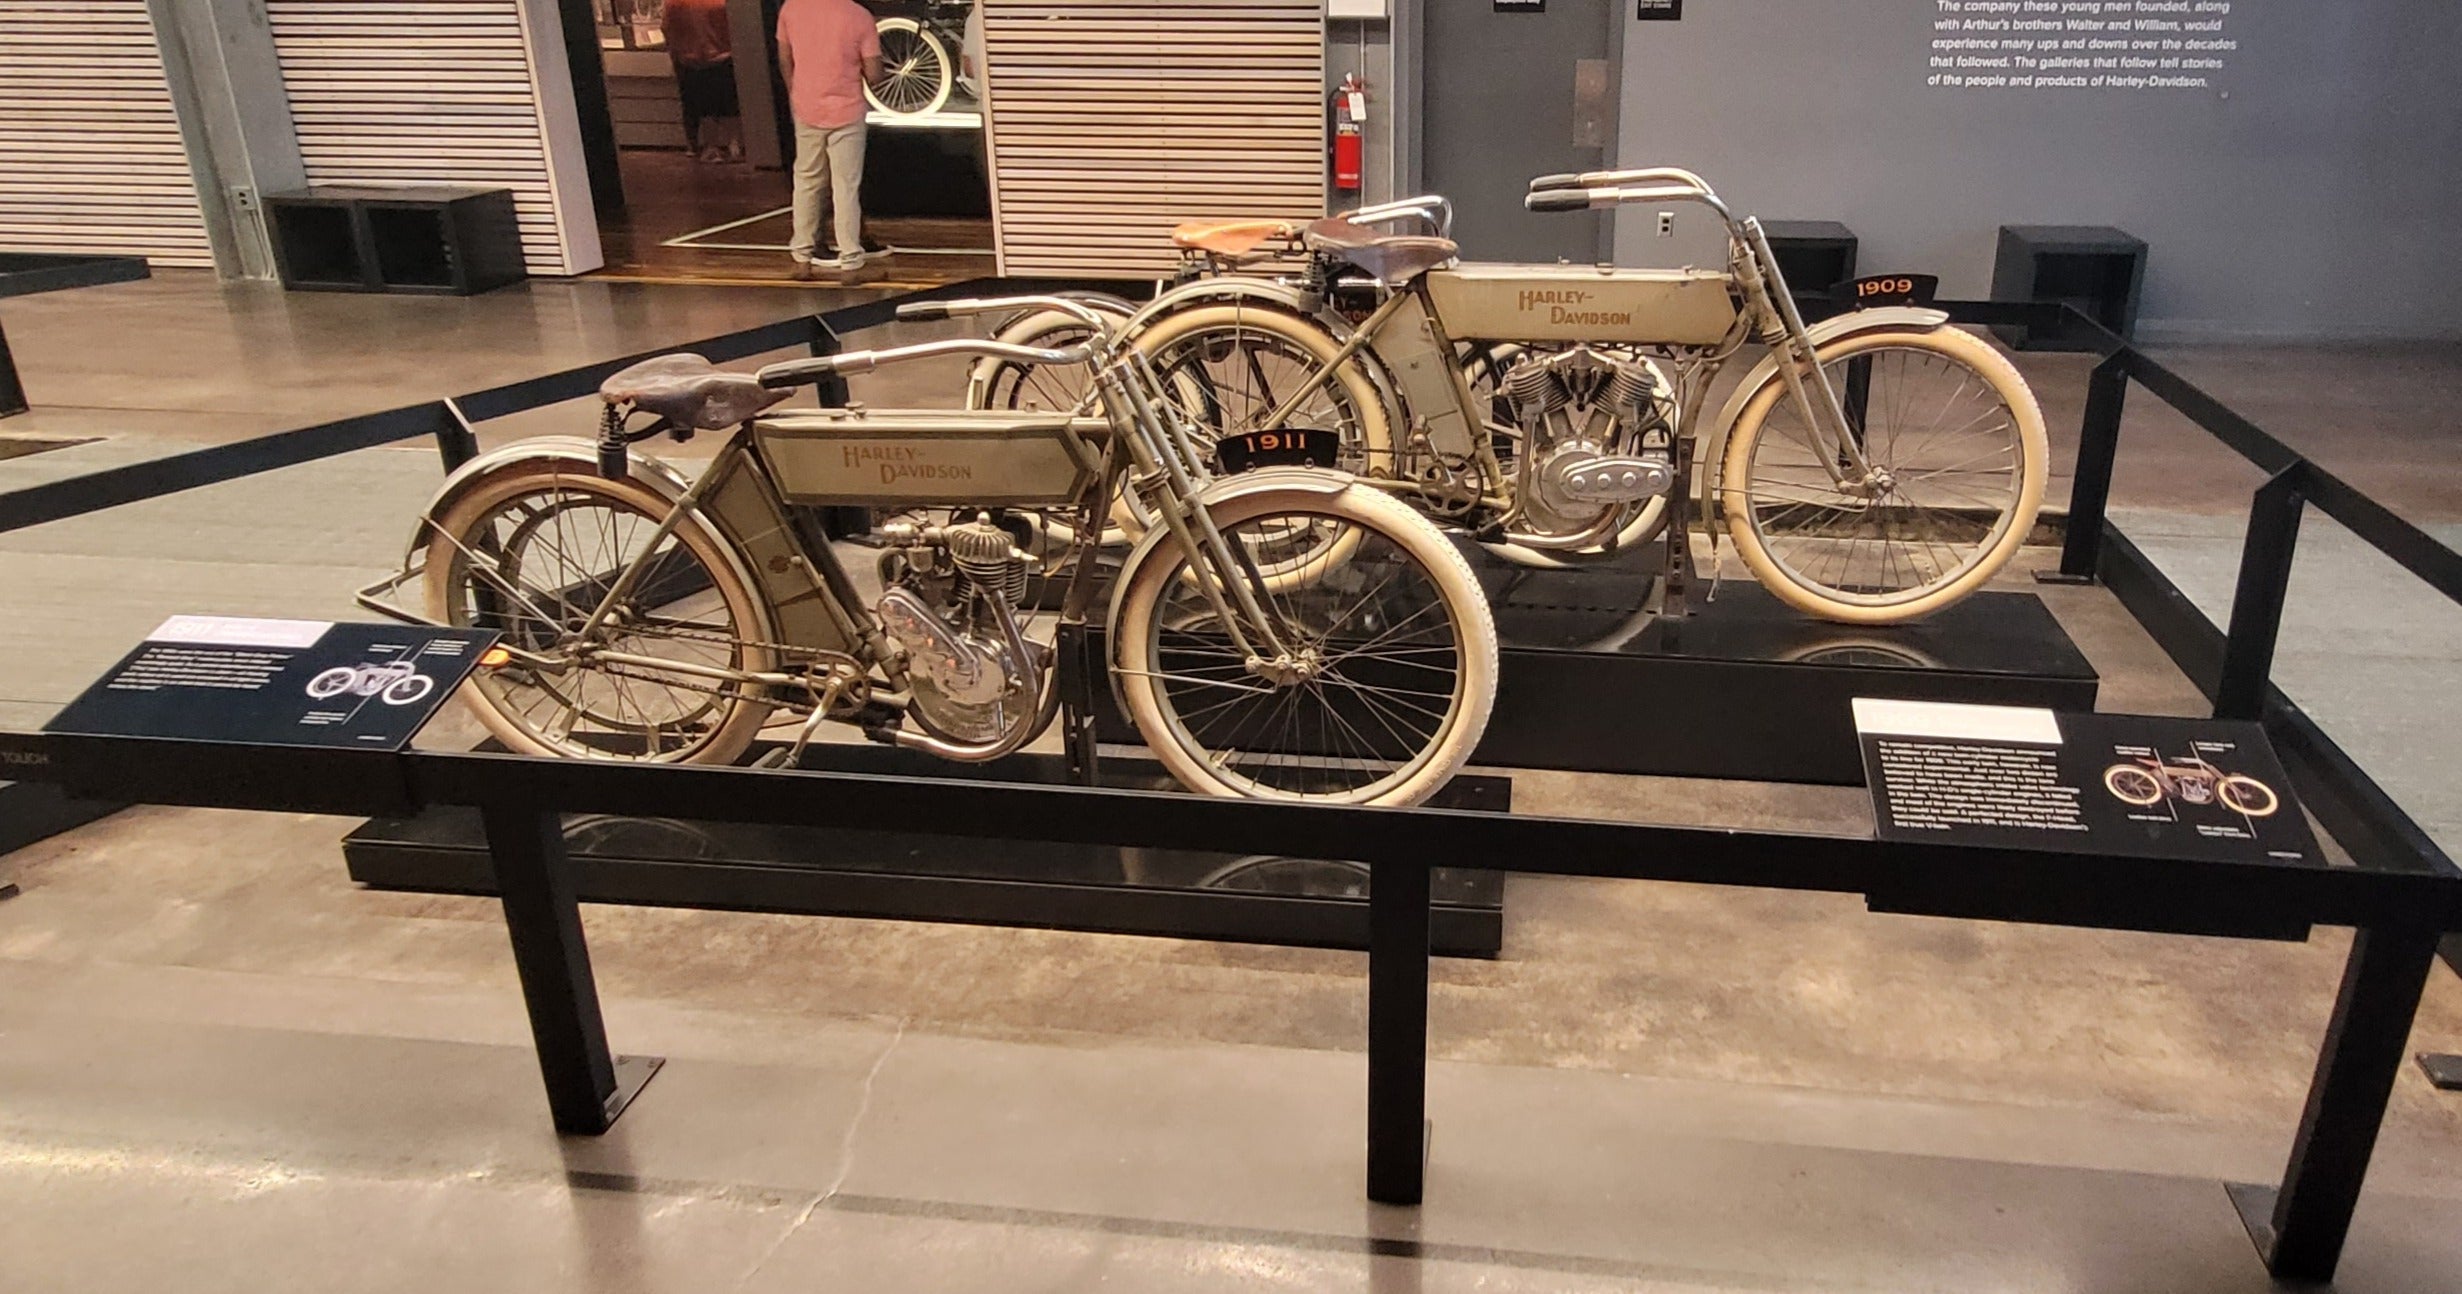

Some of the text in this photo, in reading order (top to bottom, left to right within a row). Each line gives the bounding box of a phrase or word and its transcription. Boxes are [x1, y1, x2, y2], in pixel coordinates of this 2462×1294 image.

[1937, 0, 2230, 15] The company these young men founded, along
[1934, 19, 2222, 32] with Arthur's brothers Walter and William, would
[1932, 38, 2237, 52] experience many ups and downs over the decades
[1930, 56, 2223, 70] that followed. The galleries that follow tell stories
[1927, 74, 2208, 89] of the people and products of Harley-Davidson.
[1857, 279, 1913, 297] 1909
[1518, 290, 1594, 311] HARLEY-
[1551, 306, 1631, 325] DAVIDSON
[1246, 433, 1306, 453] 1911
[843, 446, 926, 468] HARLEY-
[880, 464, 972, 485] DAVIDSON
